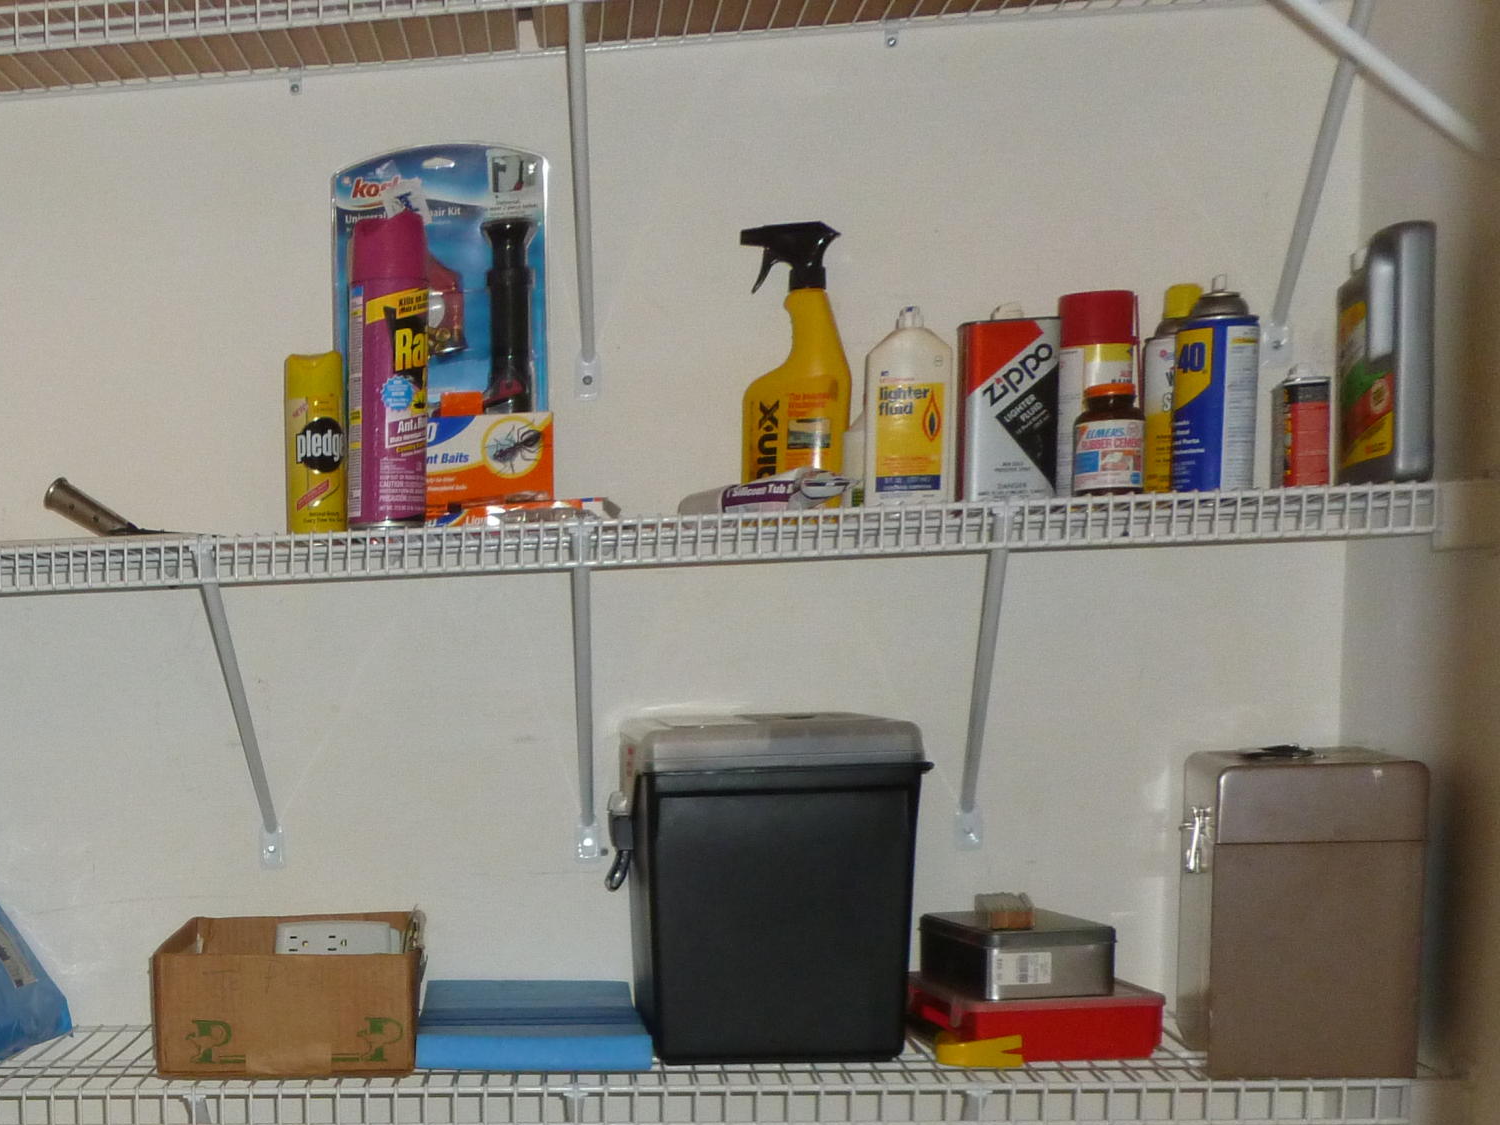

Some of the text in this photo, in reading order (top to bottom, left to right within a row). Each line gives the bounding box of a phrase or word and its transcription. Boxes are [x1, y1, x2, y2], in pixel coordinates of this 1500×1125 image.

[447, 206, 461, 217] Kit
[395, 327, 428, 373] Ra
[879, 386, 930, 403] lighter
[879, 401, 914, 416] fluid
[1003, 393, 1037, 423] LIGHTER
[1019, 401, 1045, 423] FLUID
[441, 452, 470, 464] Baits
[768, 483, 786, 494] Tub
